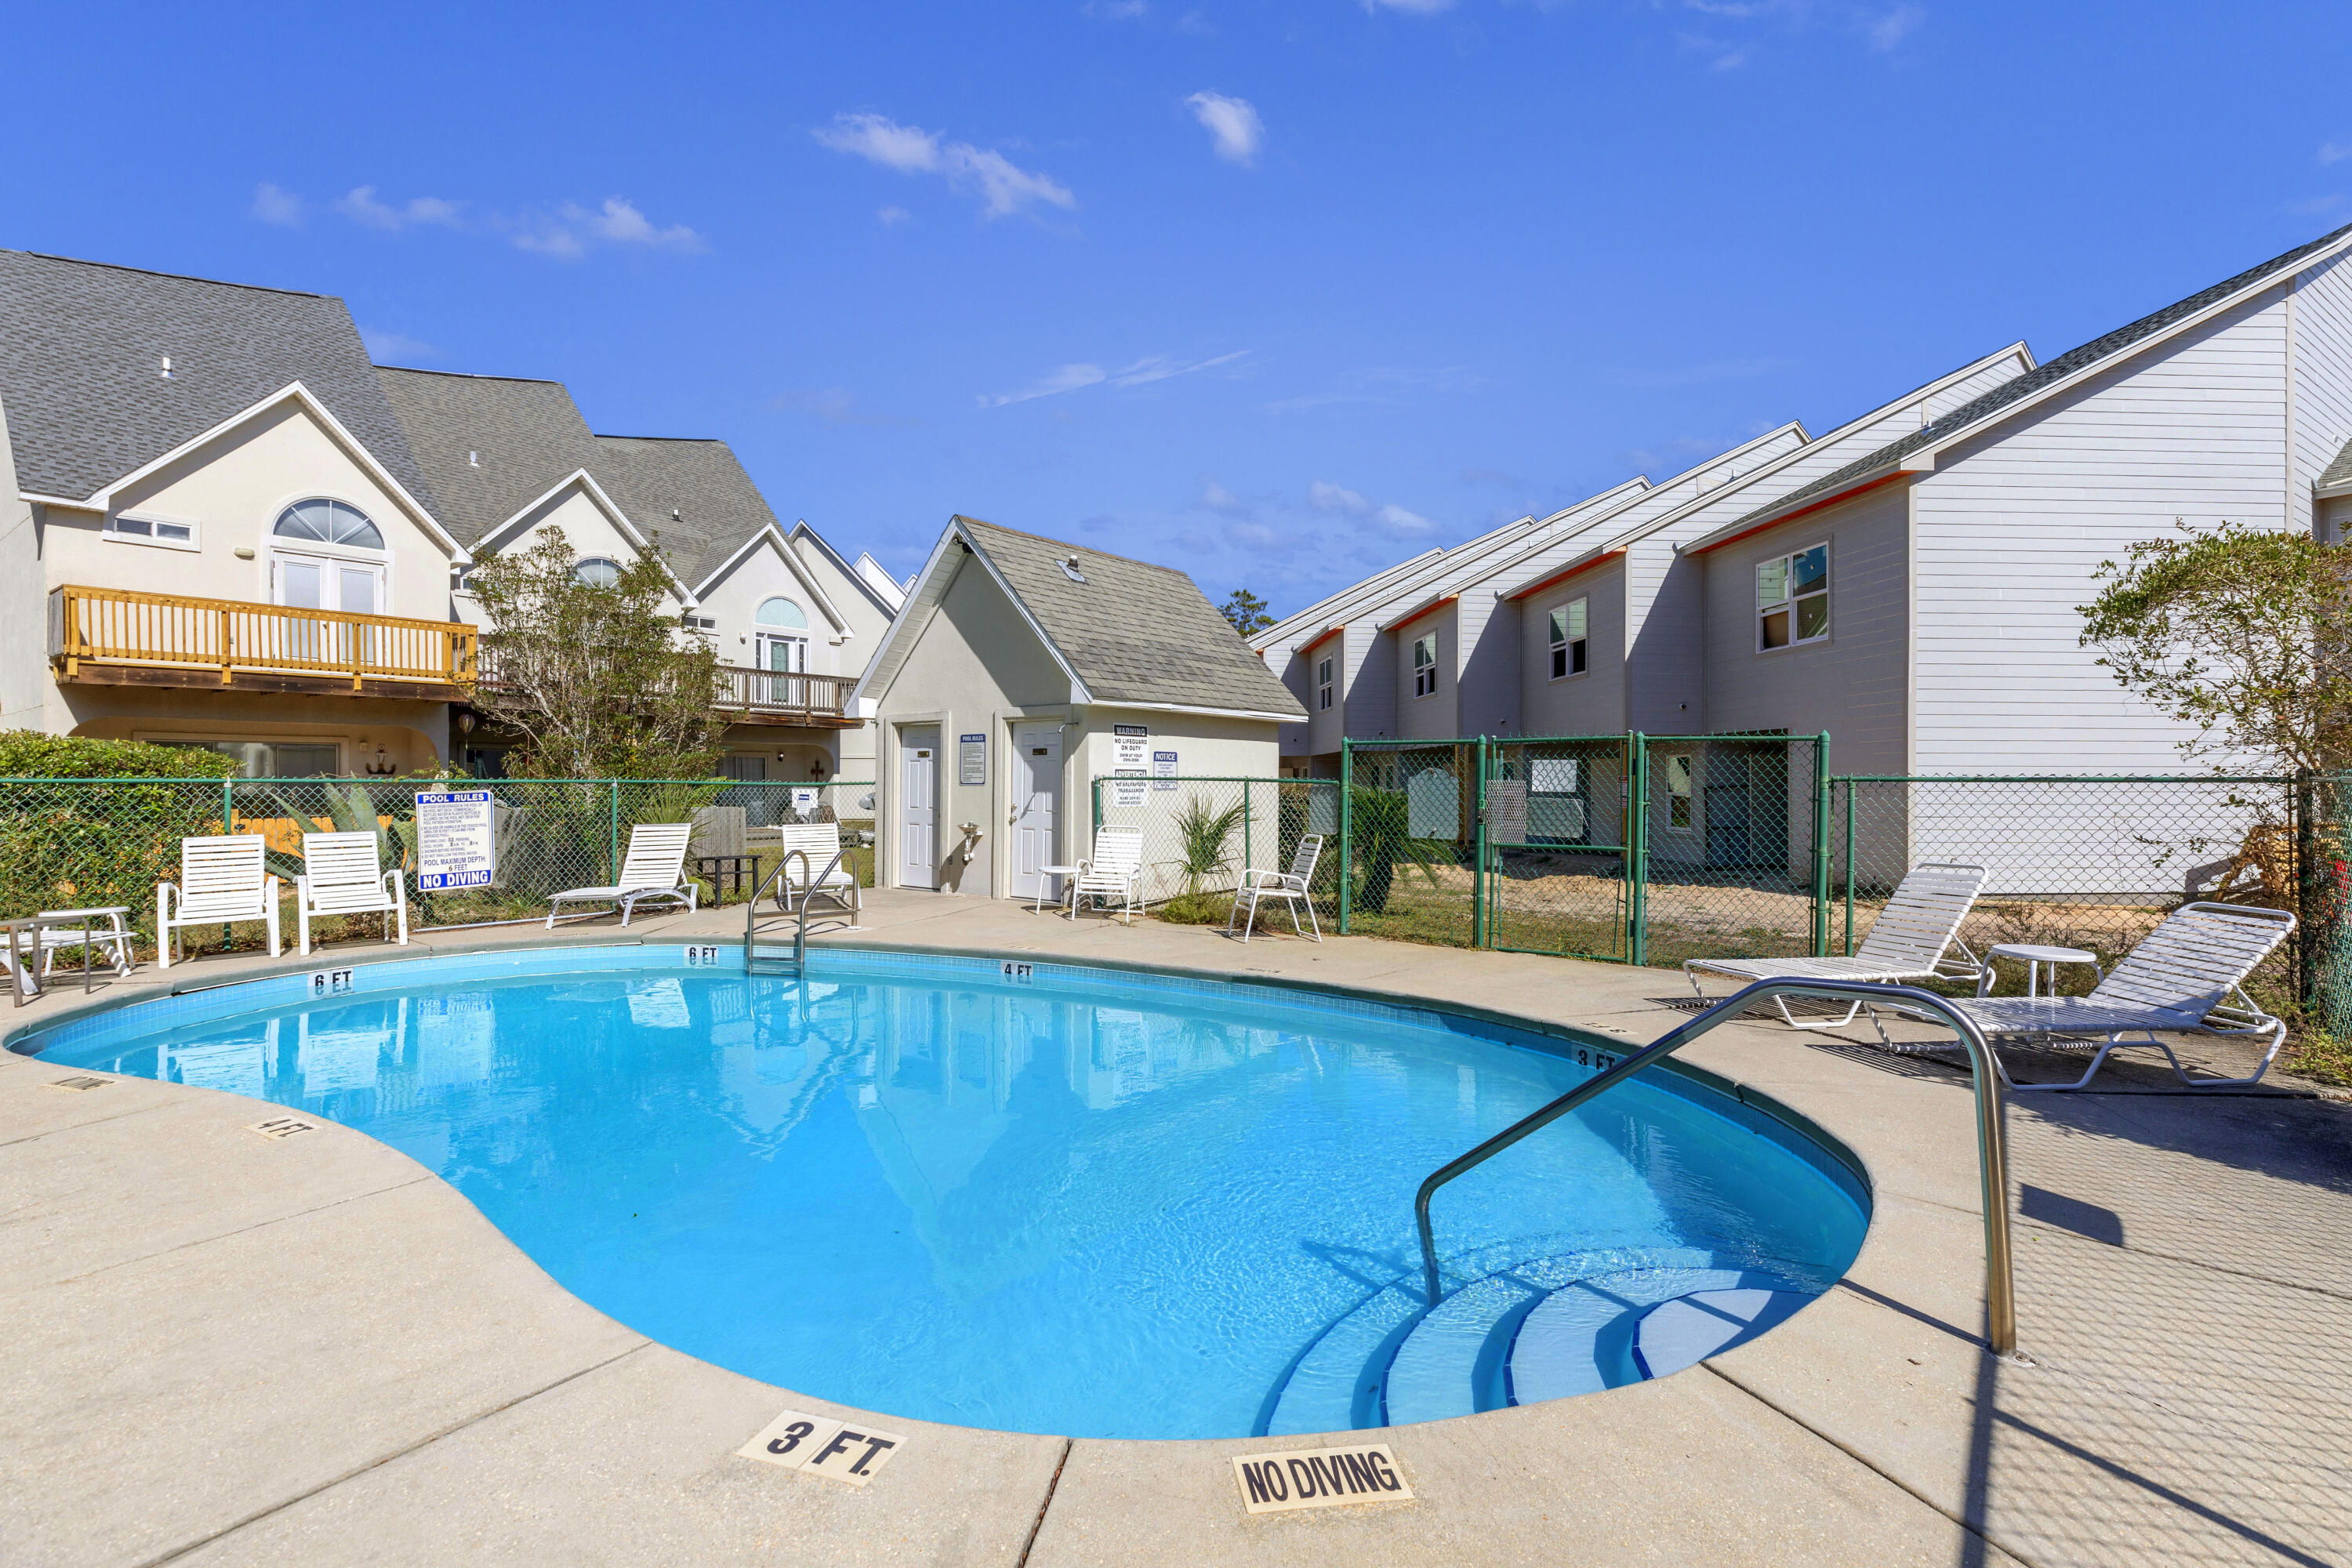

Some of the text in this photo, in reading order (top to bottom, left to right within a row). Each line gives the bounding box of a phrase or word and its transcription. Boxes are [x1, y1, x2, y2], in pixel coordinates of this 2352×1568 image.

[1116, 727, 1145, 735] WARNING
[454, 793, 484, 801] RULES
[423, 871, 488, 888] NO DIVING
[690, 947, 717, 957] 6 FT
[1005, 964, 1031, 975] 4 FT
[315, 975, 324, 986] 6
[1578, 1049, 1615, 1070] 3 FT
[767, 1421, 896, 1476] 3 FT.
[1241, 1451, 1402, 1504] NO DIVING
